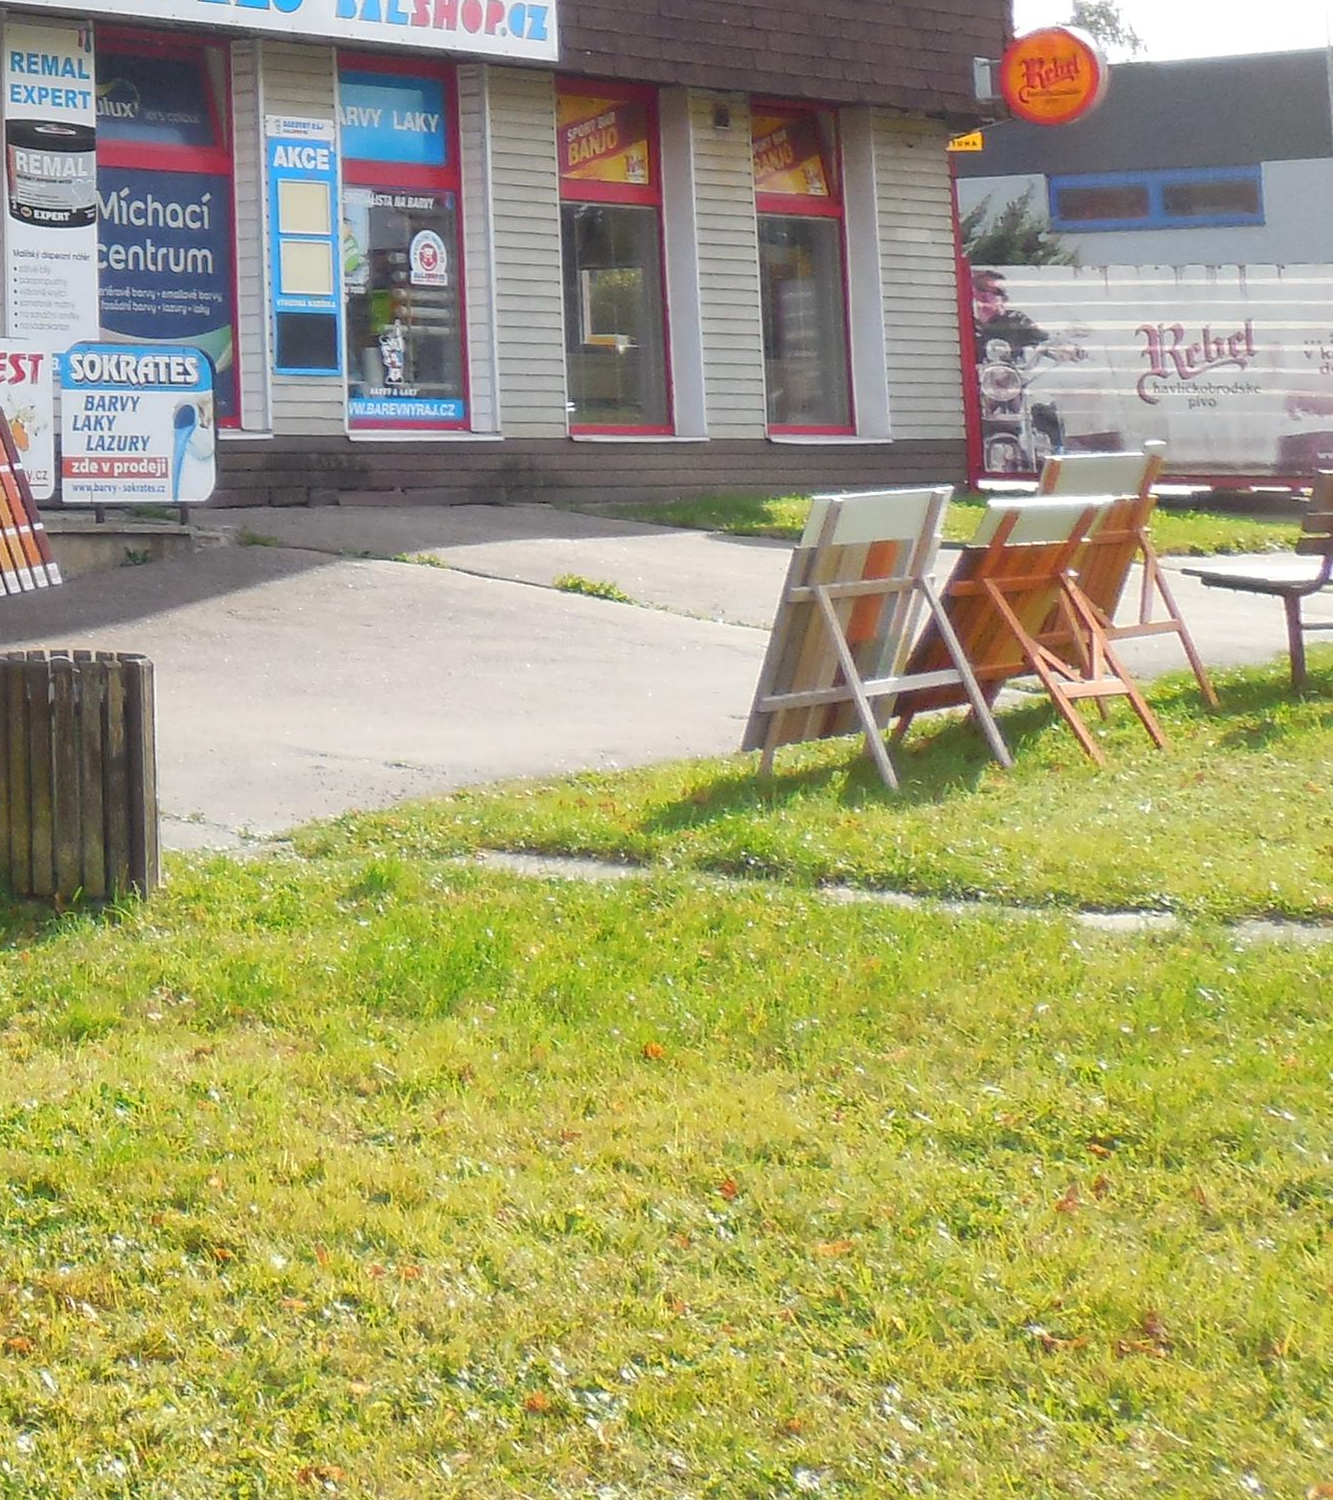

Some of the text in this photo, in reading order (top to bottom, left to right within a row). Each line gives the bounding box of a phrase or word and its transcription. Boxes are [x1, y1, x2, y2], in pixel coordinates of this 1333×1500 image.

[9, 50, 91, 81] REMAL
[1019, 54, 1081, 93] Rebel
[9, 83, 92, 110] EXPERT
[96, 96, 135, 118] ulux
[339, 103, 440, 134] ARVY LAKY
[568, 127, 619, 167] BANJO
[950, 139, 978, 149] TUNA
[16, 150, 89, 178] REMAL
[273, 145, 331, 171] AKCE
[34, 209, 71, 221] EXPERT
[95, 186, 213, 230] Míchací
[394, 194, 406, 209] NA
[407, 195, 435, 210] BARVY
[97, 238, 214, 275] centrum
[1134, 317, 1259, 380] Rebel
[70, 353, 199, 387] SOKRATES
[84, 395, 141, 413] BARVY
[1188, 397, 1217, 410] pivo
[72, 414, 117, 432] LAKY
[86, 435, 151, 452] LAZURY
[72, 458, 167, 478] zde v prodeji
